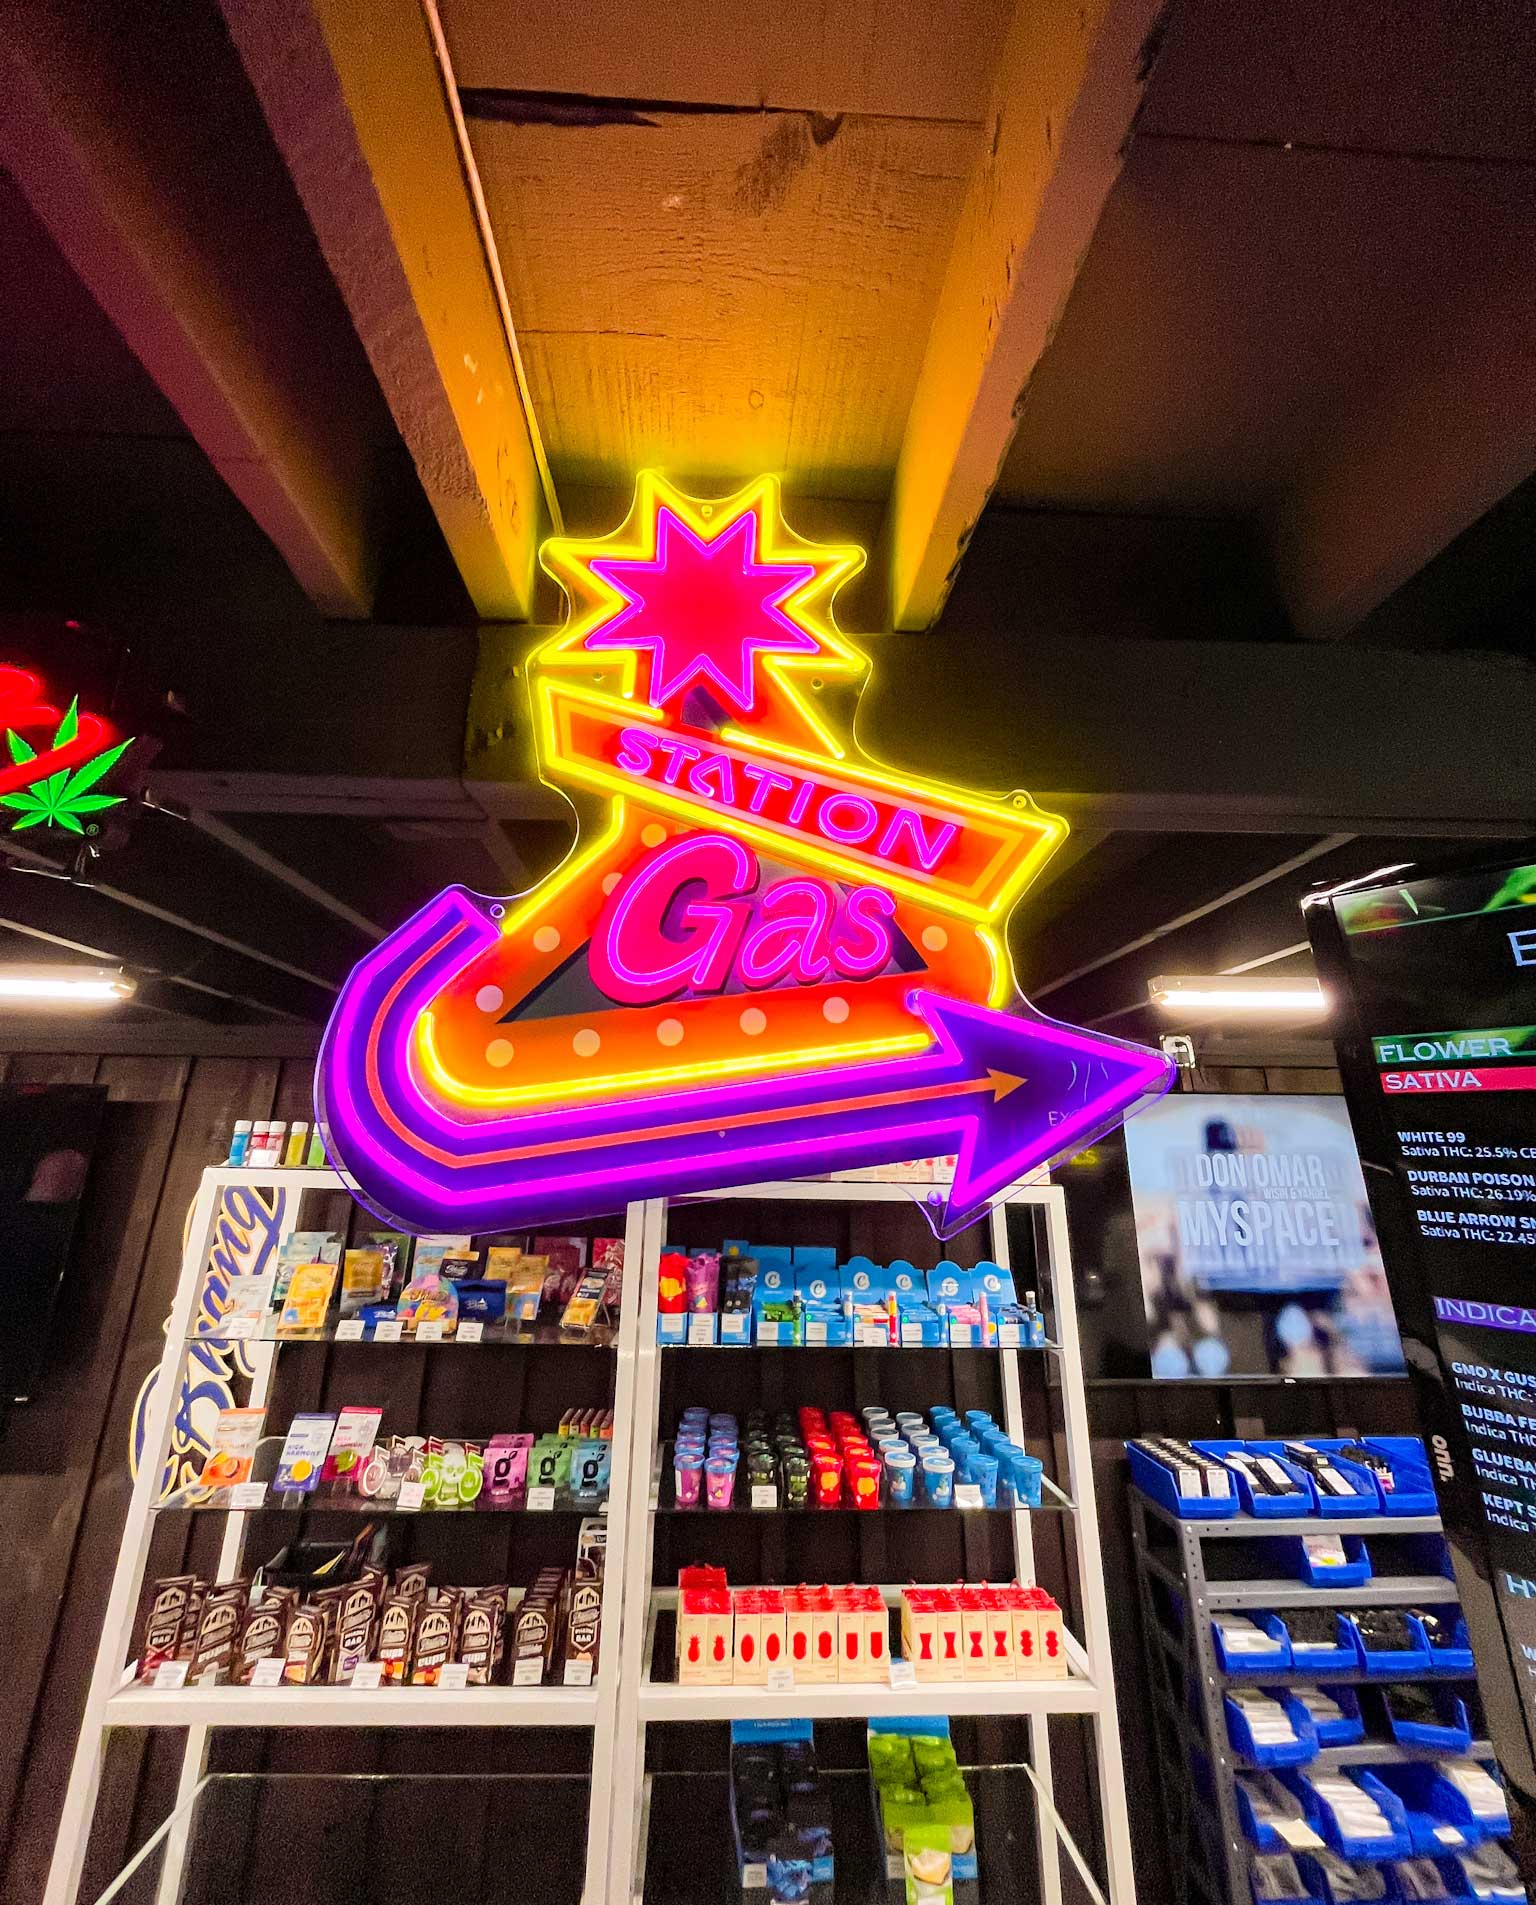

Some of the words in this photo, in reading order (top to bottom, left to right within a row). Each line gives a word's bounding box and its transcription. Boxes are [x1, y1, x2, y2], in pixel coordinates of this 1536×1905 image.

[615, 726, 957, 869] STATION
[588, 829, 898, 1007] Gas
[1379, 1037, 1512, 1062] FLOWER
[1385, 1071, 1482, 1089] SATIVA
[1397, 1131, 1445, 1143] WHITE
[1447, 1132, 1466, 1143] 99
[1401, 1146, 1440, 1156] Sativa
[1441, 1147, 1473, 1158] THC:
[1476, 1147, 1518, 1158] 25.5%
[1197, 1154, 1247, 1187] DON
[1253, 1154, 1325, 1187] OMAR
[1407, 1170, 1470, 1184] DURBAN
[1473, 1172, 1536, 1187] POISON
[1411, 1185, 1450, 1197] Sativa
[1451, 1187, 1483, 1199] THC:
[1180, 1201, 1340, 1246] MYSPACE
[1417, 1209, 1457, 1223] BLUE
[1458, 1212, 1516, 1228] ARROW
[1420, 1225, 1460, 1239] Sativa
[1461, 1227, 1495, 1242] THC:
[1497, 1230, 1536, 1245] 22.45
[1437, 1298, 1536, 1326] INDICA
[1451, 1362, 1487, 1378] GMO
[1489, 1368, 1502, 1381] X
[1455, 1377, 1496, 1395] Indica
[1496, 1385, 1534, 1403] THC:
[1461, 1403, 1517, 1427] BUBBA
[1465, 1420, 1507, 1440] Indica
[1472, 1447, 1536, 1475] GLUEBA
[1475, 1464, 1519, 1486] Indica
[1481, 1491, 1524, 1515] KEPT
[1486, 1509, 1530, 1533] Indica
